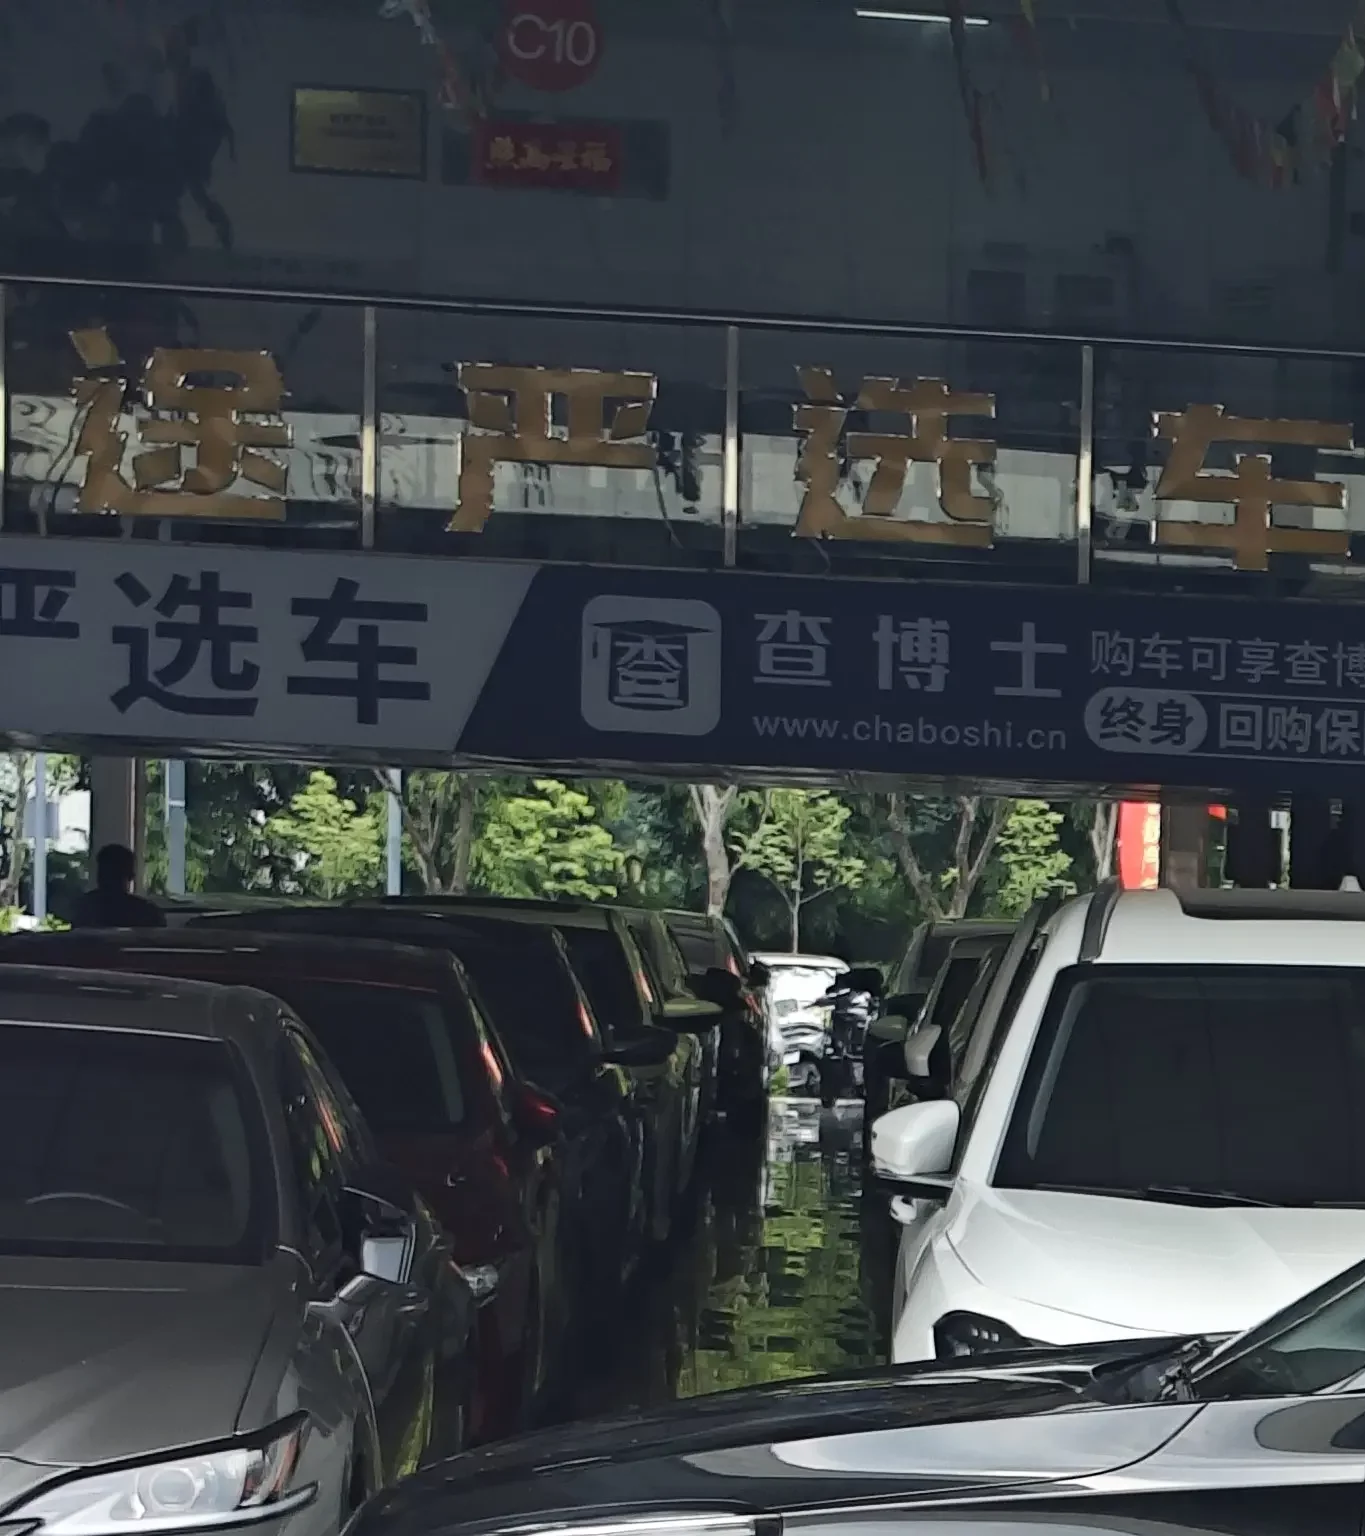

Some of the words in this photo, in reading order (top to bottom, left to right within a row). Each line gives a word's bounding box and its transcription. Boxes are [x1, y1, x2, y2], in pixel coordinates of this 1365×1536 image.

[508, 13, 596, 66] C10
[752, 610, 1068, 698] 查博士
[752, 714, 1067, 751] www.chaboshi.cn
[1099, 689, 1194, 746] 终身
